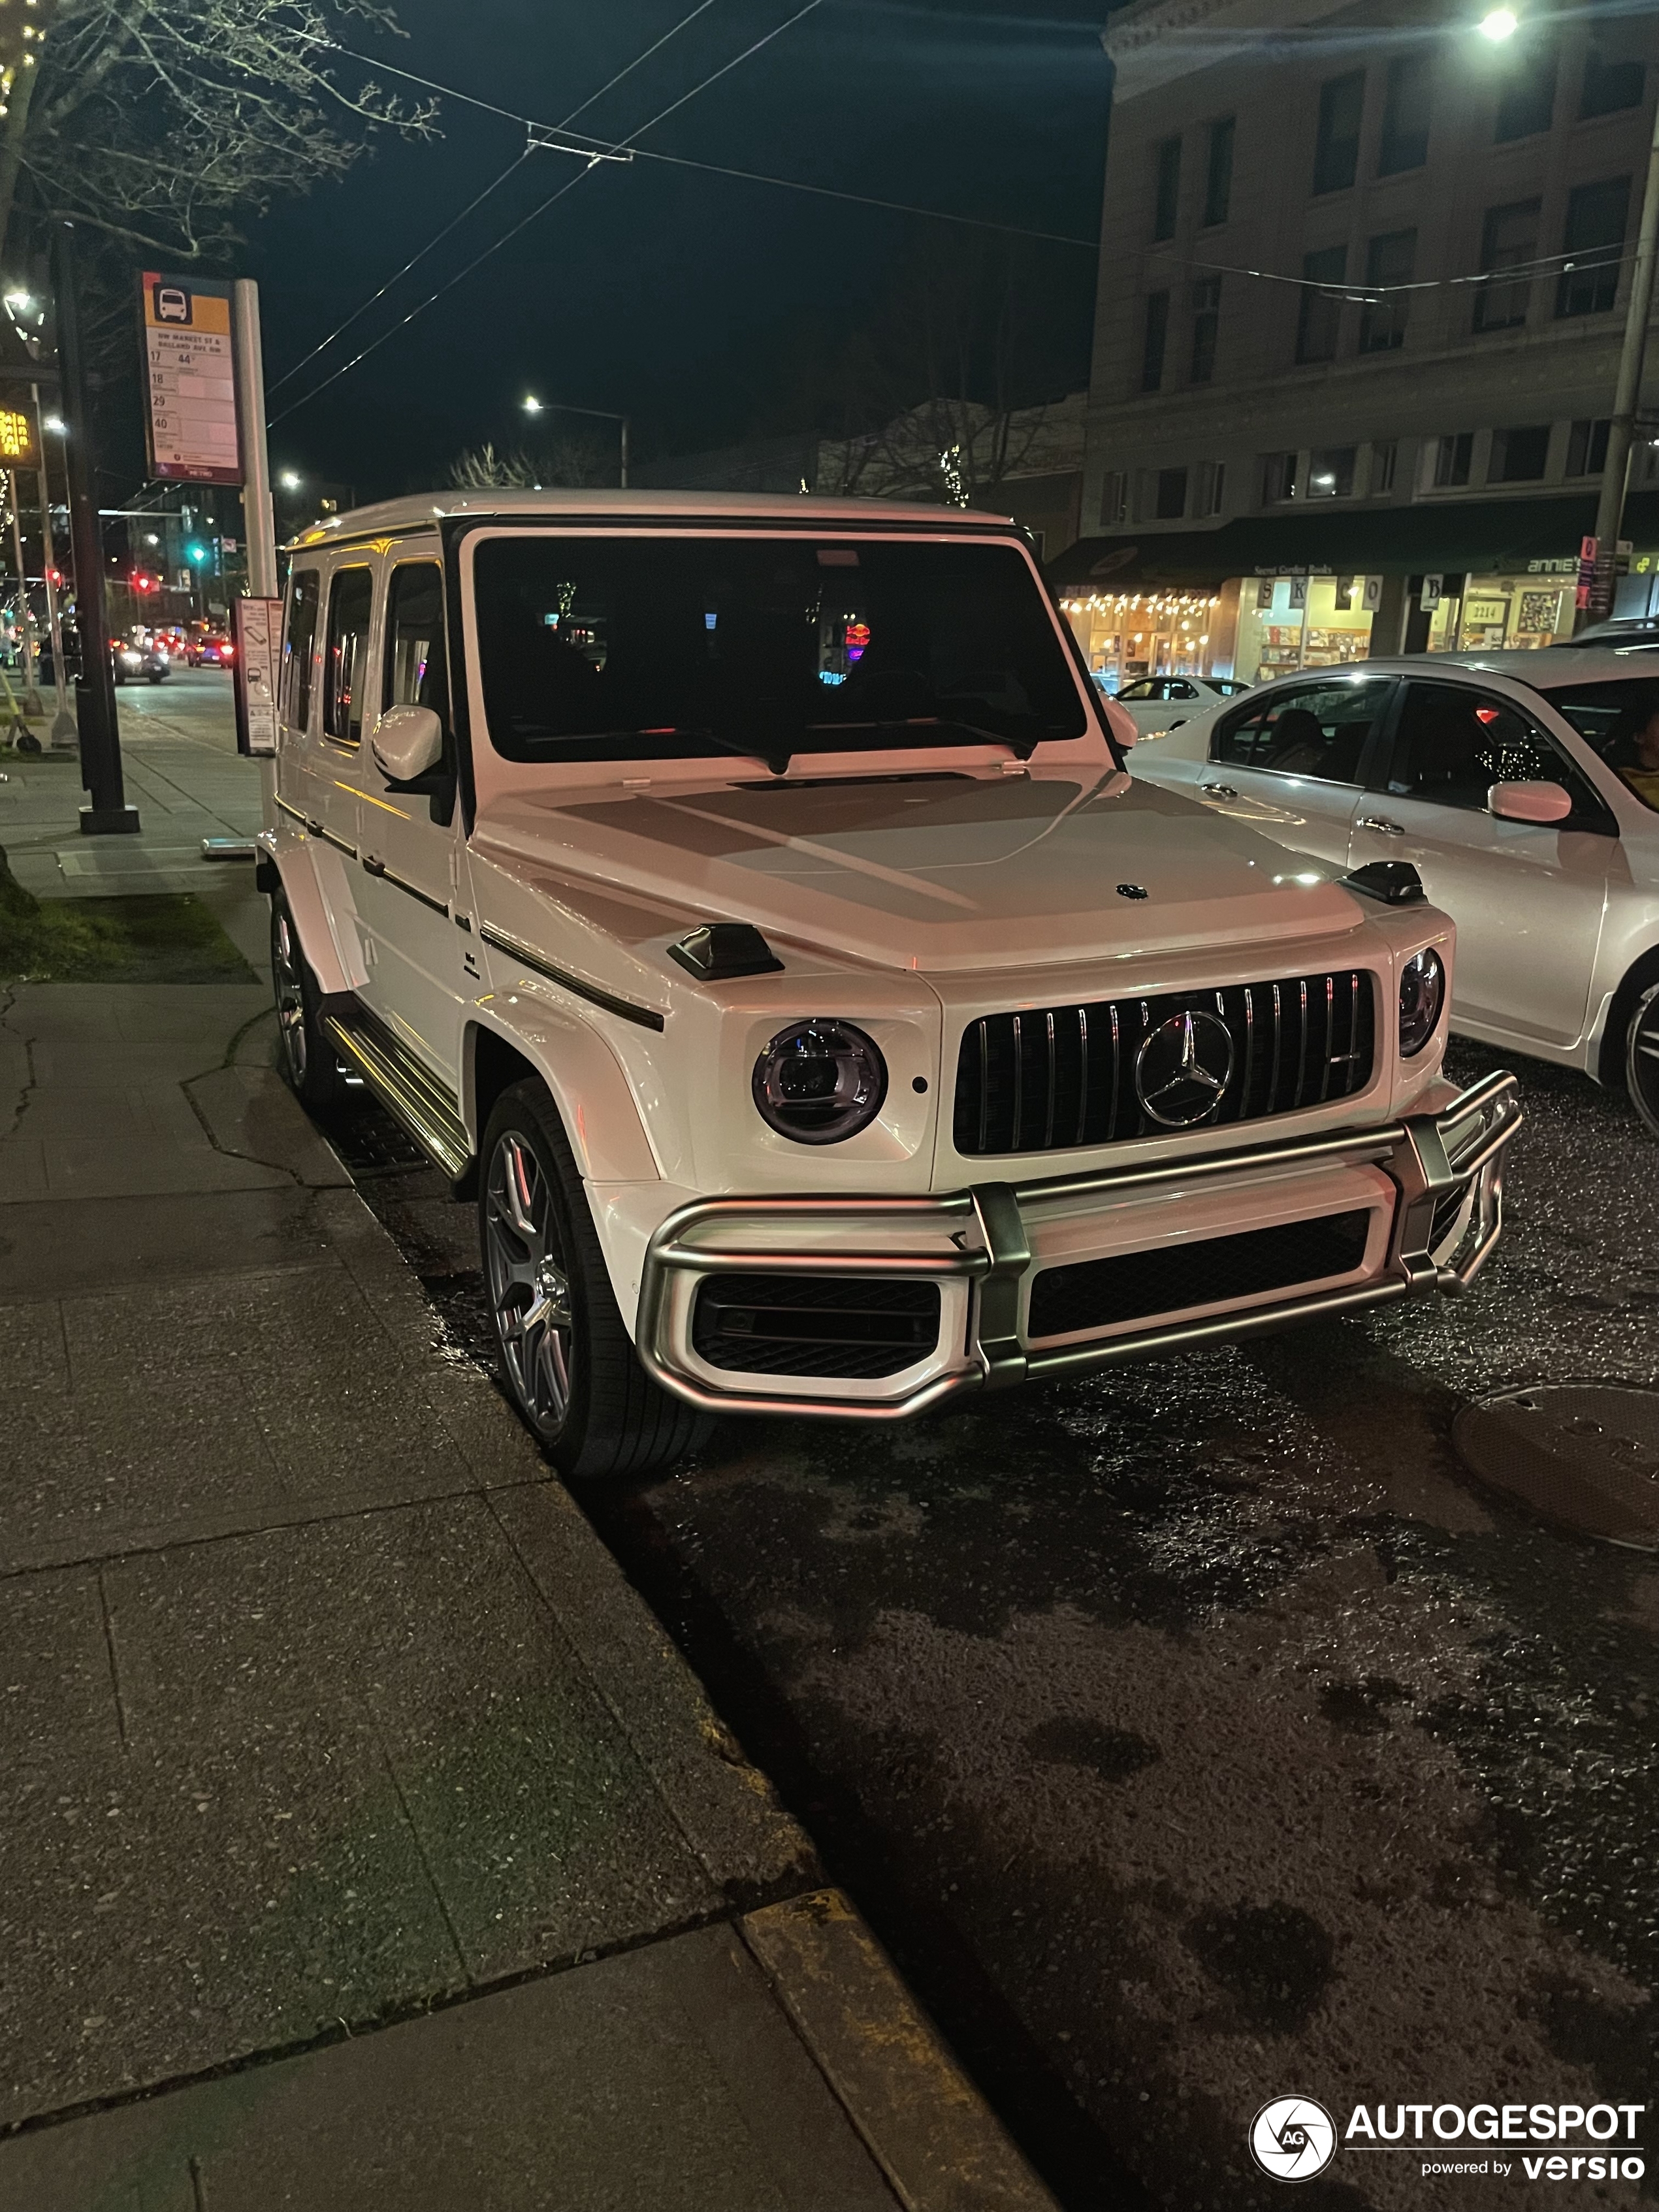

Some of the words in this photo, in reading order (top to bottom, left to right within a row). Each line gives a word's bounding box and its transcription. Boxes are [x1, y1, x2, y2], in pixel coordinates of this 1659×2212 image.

[172, 334, 201, 343] MARKET
[158, 341, 191, 349] BALLARD
[150, 351, 161, 361] 17
[178, 354, 190, 364] 44
[152, 374, 163, 383] 18
[153, 395, 165, 406] 29
[155, 418, 167, 428] 40
[1254, 566, 1276, 575] Secret
[1279, 564, 1306, 575] Garden
[1308, 564, 1332, 575] Books
[1263, 583, 1272, 600] S
[1294, 583, 1304, 599] K
[1368, 581, 1378, 600] O
[1429, 579, 1440, 598] B
[1474, 606, 1496, 618] 2214
